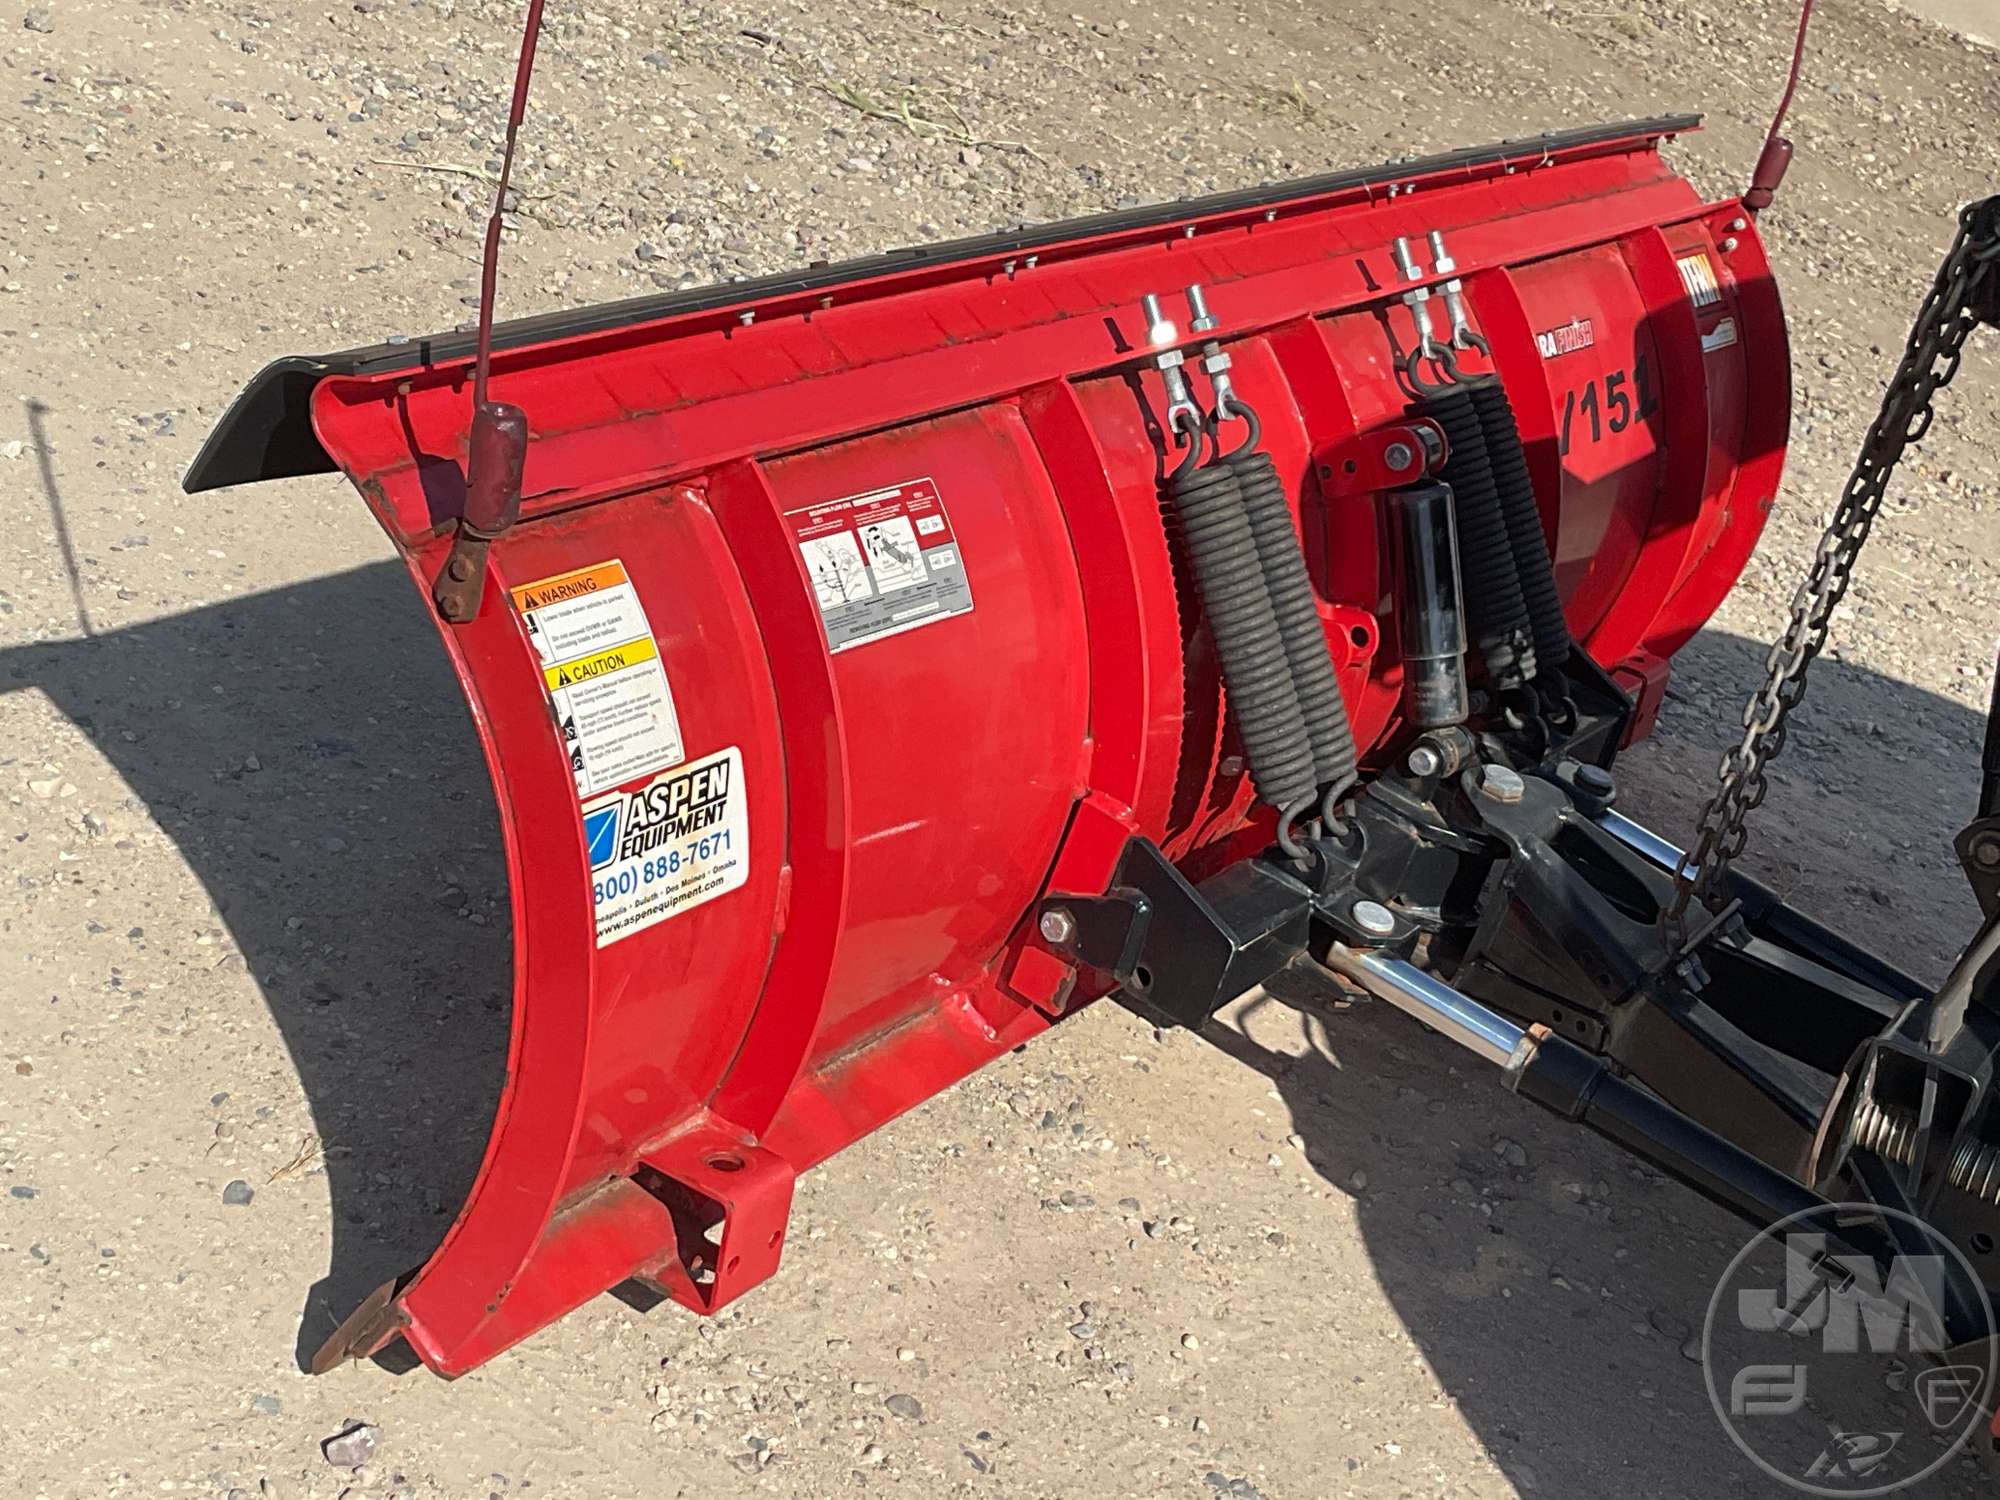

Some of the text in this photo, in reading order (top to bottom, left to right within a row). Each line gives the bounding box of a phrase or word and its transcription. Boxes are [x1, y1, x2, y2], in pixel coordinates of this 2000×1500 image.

[538, 577, 598, 605] WARNING
[572, 653, 625, 681] CAUTION
[624, 757, 730, 838] ASPEN
[619, 800, 728, 862] EQUIPMENT
[643, 828, 731, 884] 888-7671
[665, 883, 680, 895] Des
[681, 872, 706, 889] Moines
